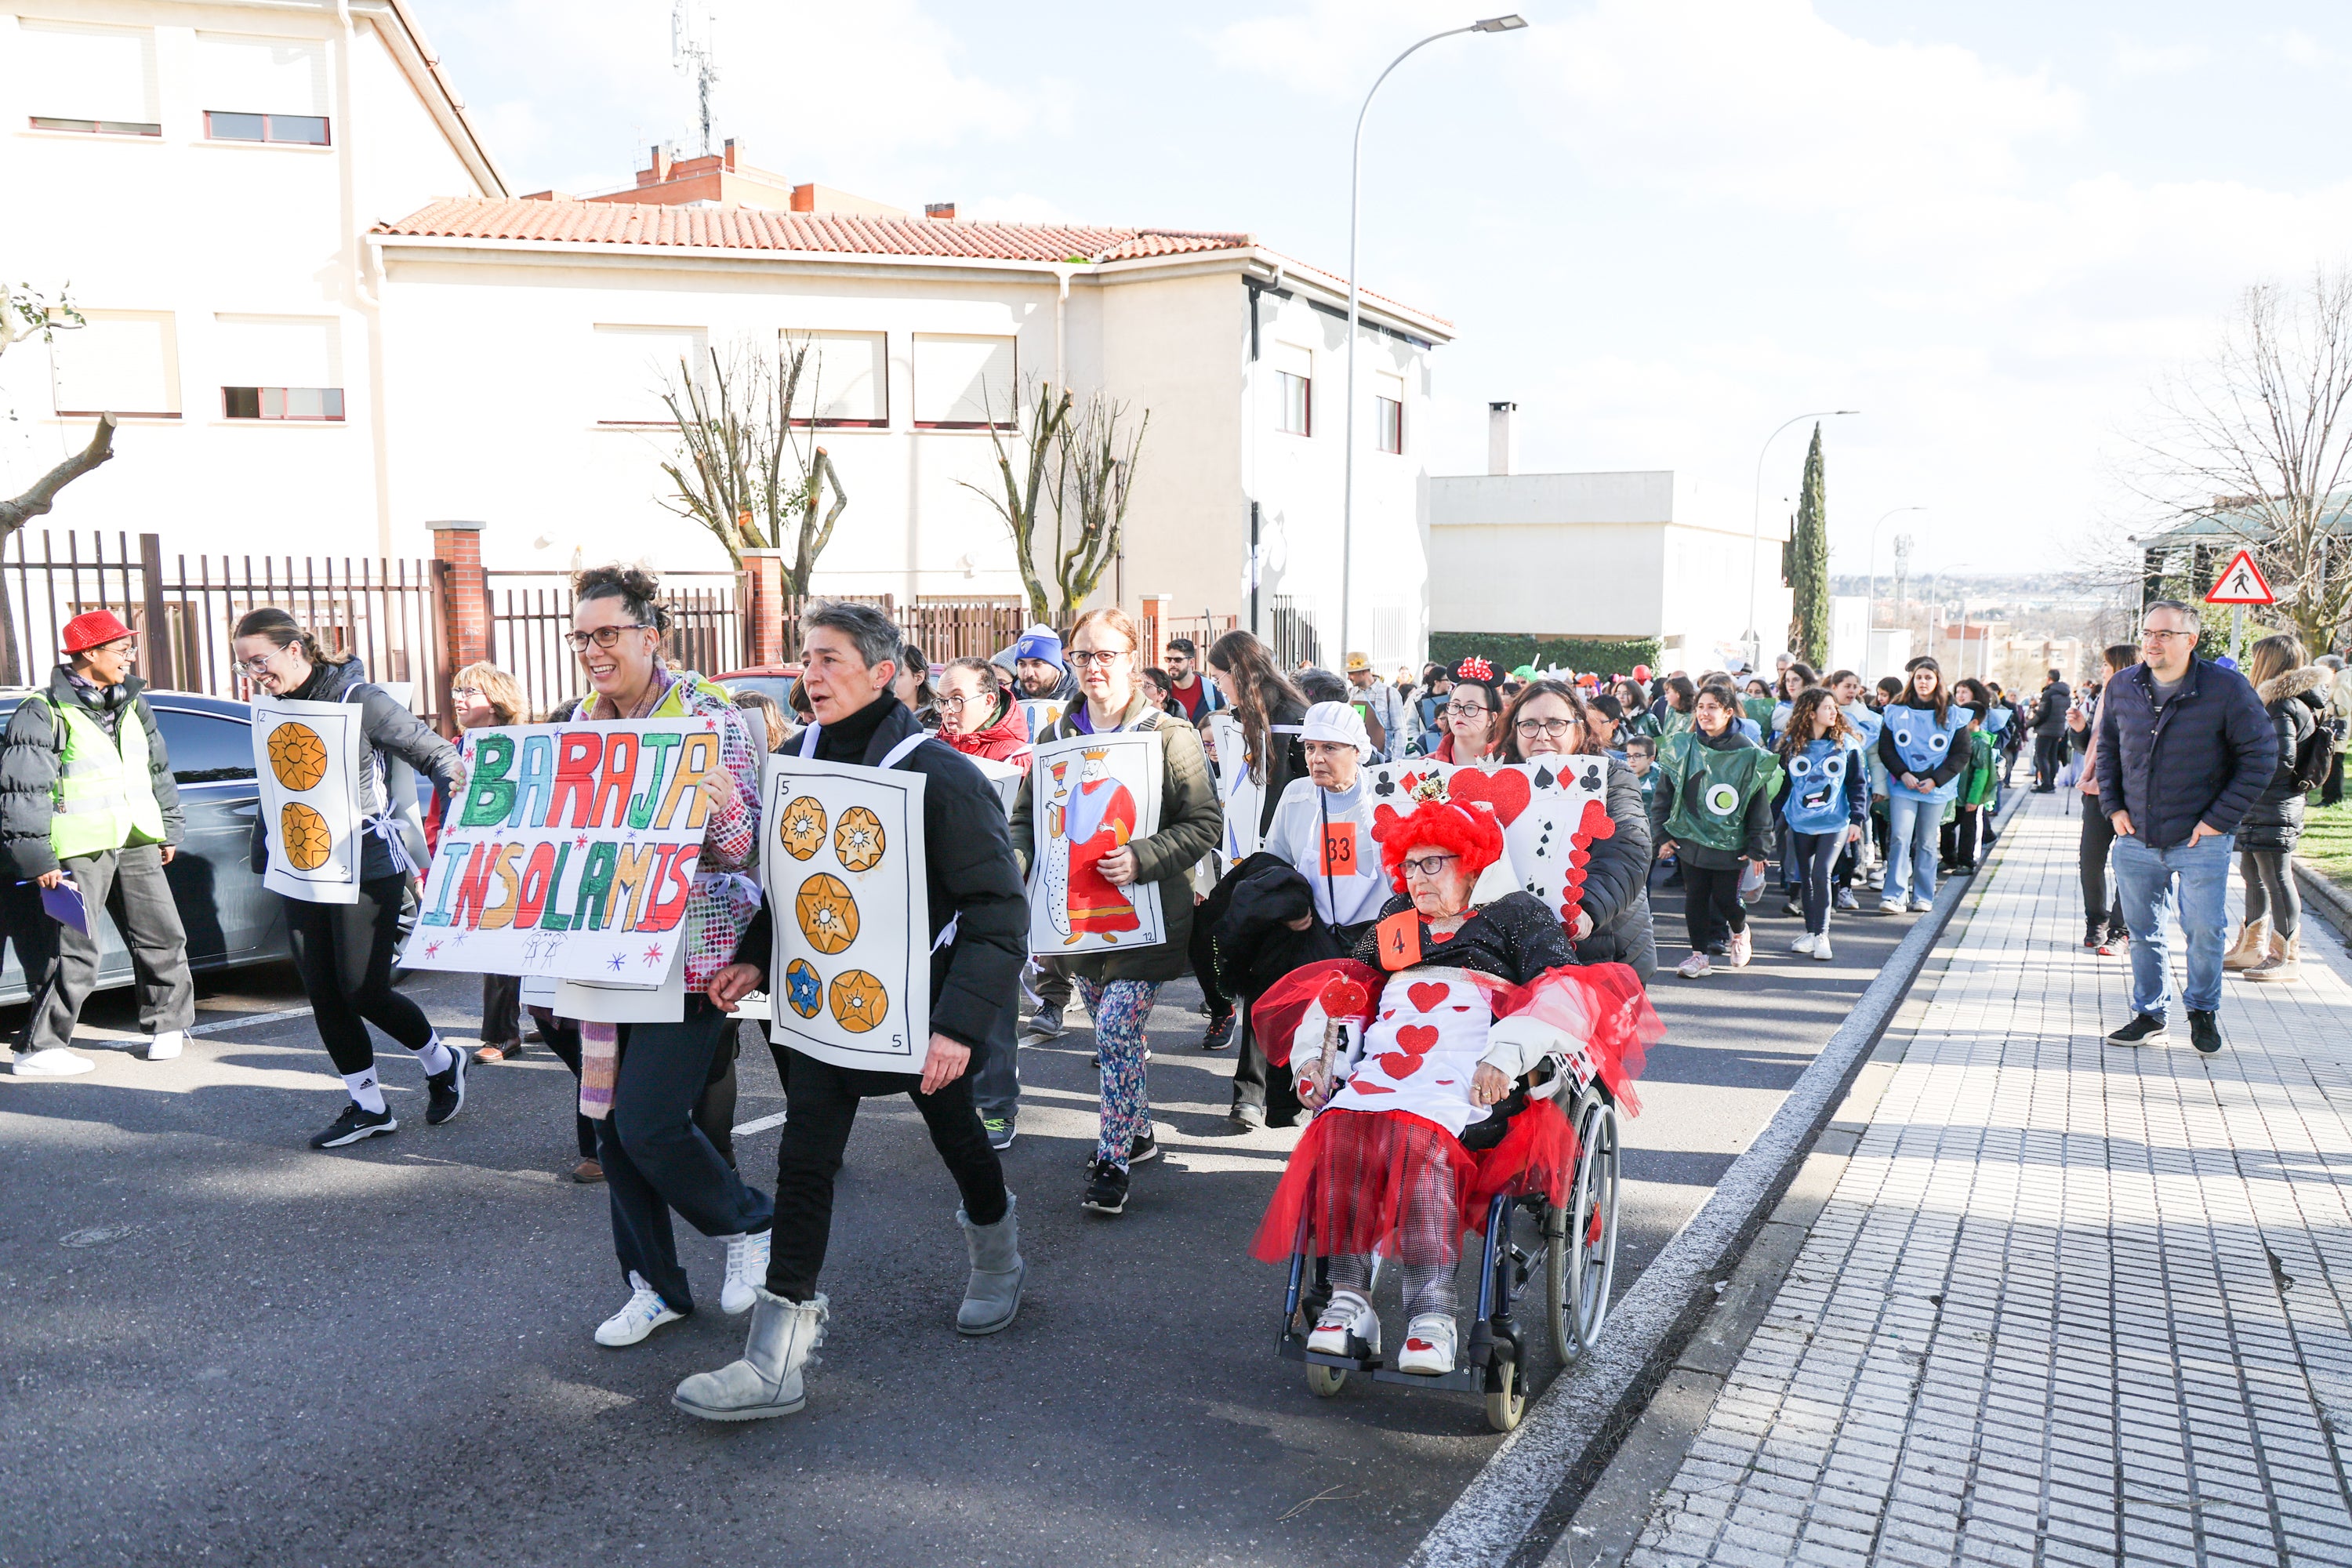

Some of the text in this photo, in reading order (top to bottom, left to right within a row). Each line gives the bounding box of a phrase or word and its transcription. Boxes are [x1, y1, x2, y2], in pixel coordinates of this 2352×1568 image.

[260, 713, 266, 722] 2
[1041, 757, 1051, 769] 12
[459, 731, 720, 830] BARAJA
[781, 780, 790, 795] 5
[340, 865, 349, 875] 2
[421, 840, 702, 933] INSOLAMIS
[1142, 931, 1155, 942] 12
[1392, 927, 1406, 955] 4
[891, 1034, 902, 1047] 5
